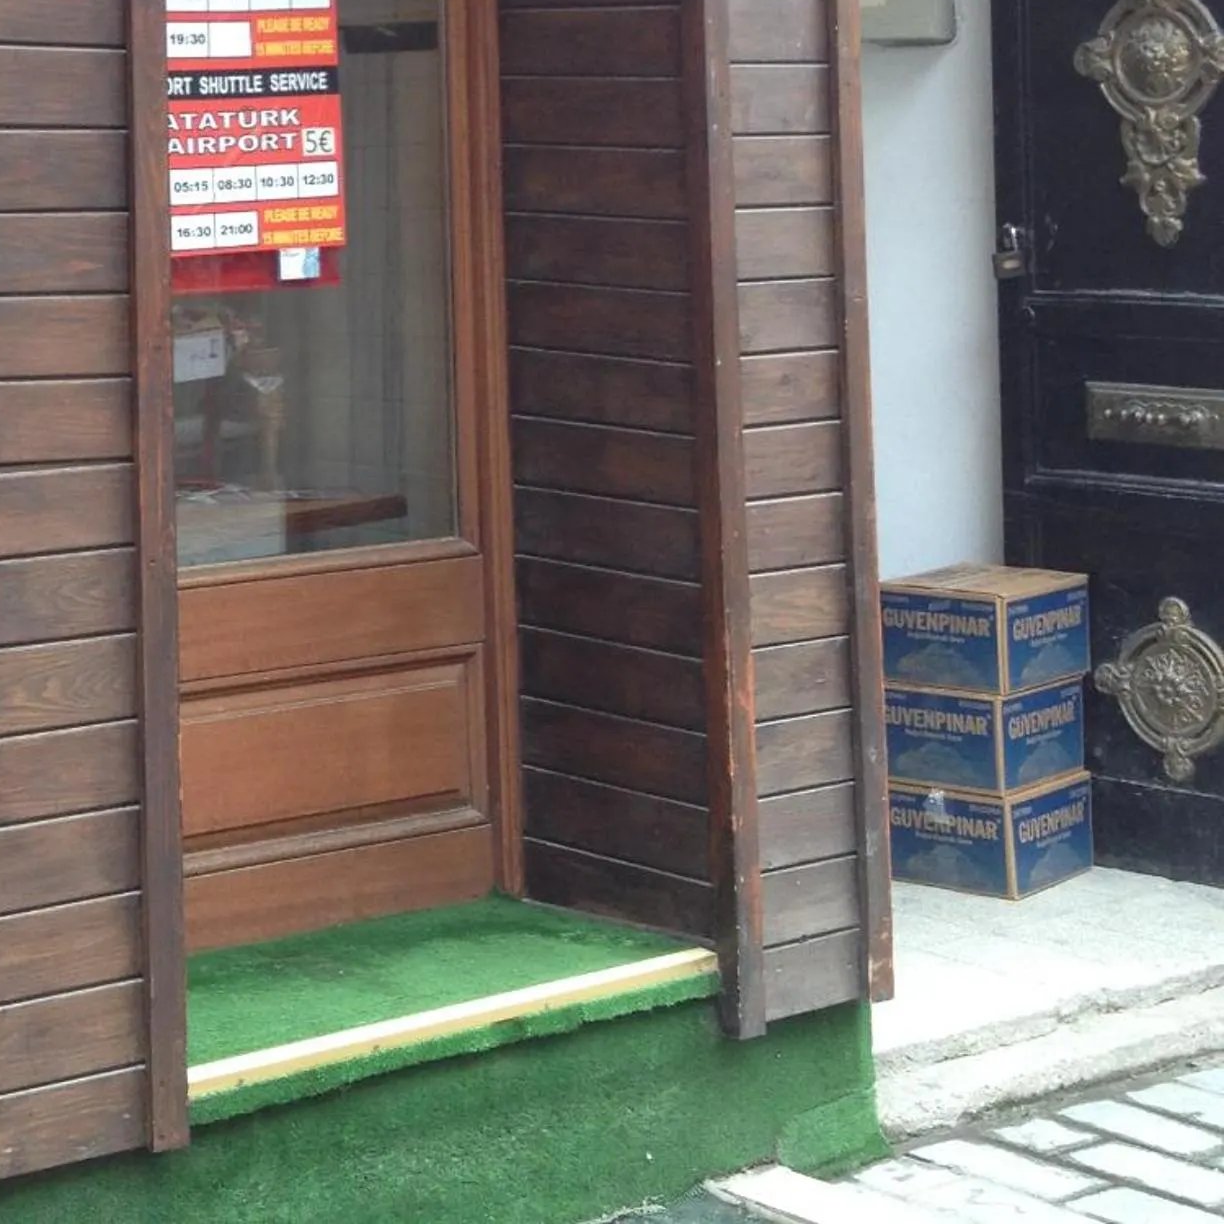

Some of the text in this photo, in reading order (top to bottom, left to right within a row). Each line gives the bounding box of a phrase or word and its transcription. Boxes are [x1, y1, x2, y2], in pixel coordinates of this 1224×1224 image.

[170, 33, 206, 46] 19:30
[199, 74, 263, 95] SHUTTLE
[270, 71, 328, 93] SERVICE
[167, 130, 333, 155] AIRPORT 5€
